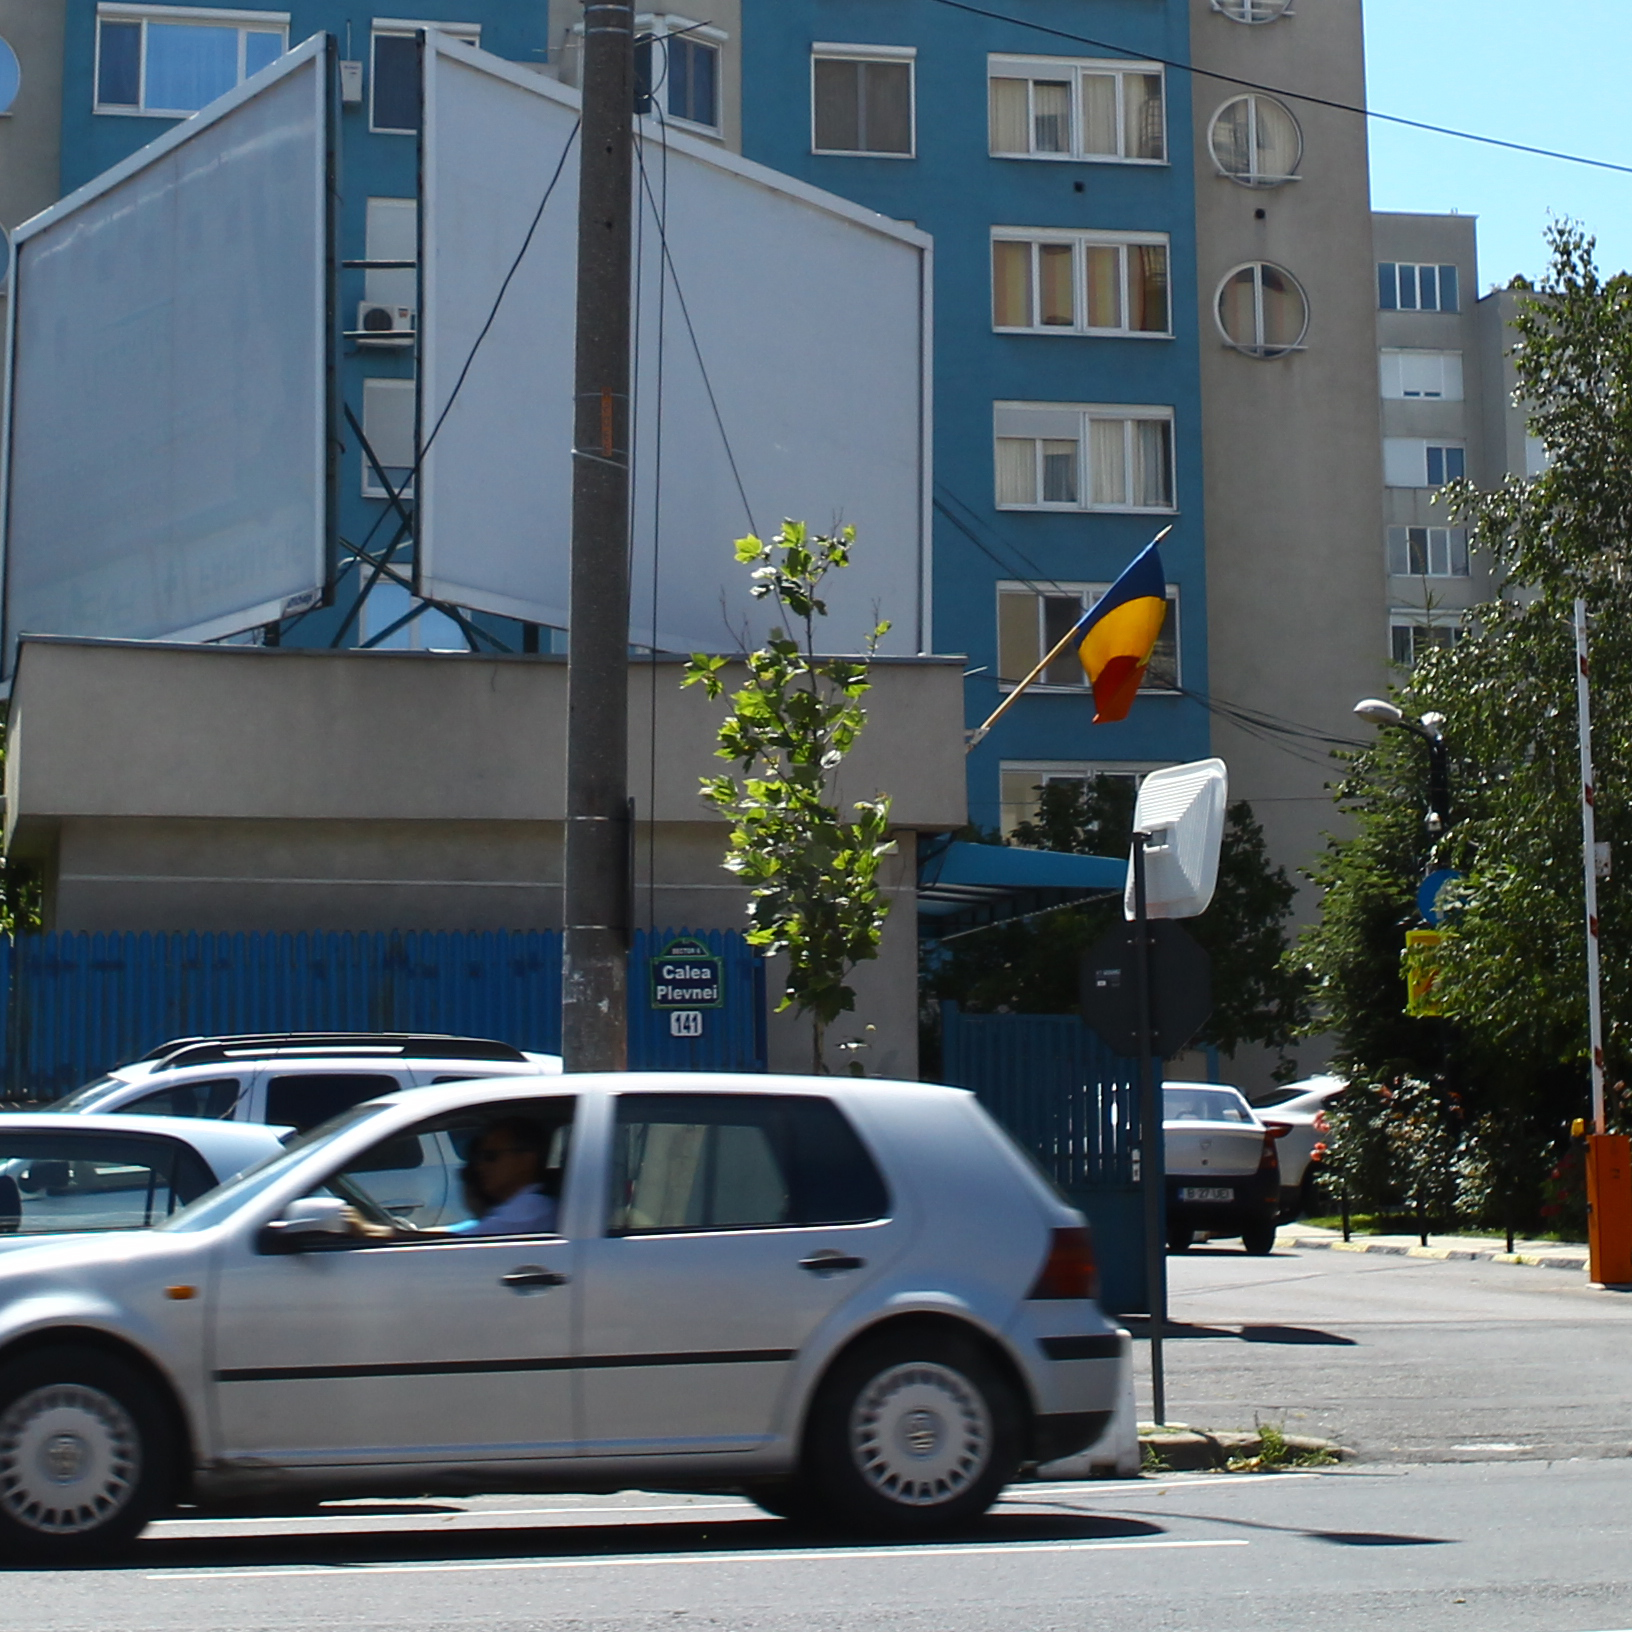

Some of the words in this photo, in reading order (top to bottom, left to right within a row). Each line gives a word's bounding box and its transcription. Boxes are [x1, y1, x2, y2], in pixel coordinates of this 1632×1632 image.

[662, 965, 711, 980] Calea
[656, 984, 718, 1000] Plevnei
[675, 1013, 699, 1034] 141
